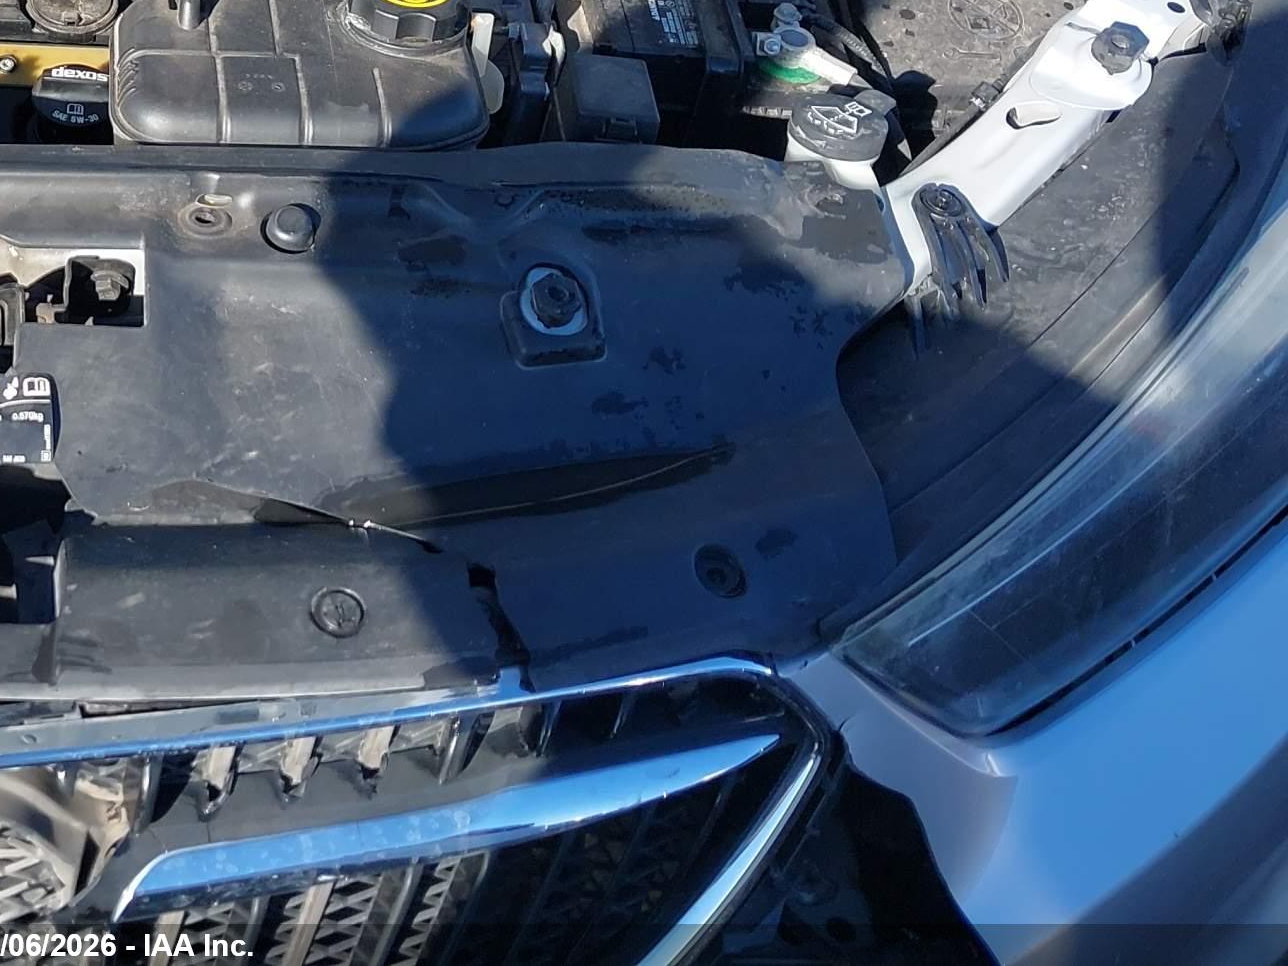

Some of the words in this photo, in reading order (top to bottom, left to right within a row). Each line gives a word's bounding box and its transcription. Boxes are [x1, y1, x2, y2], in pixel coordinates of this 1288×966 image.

[52, 66, 109, 82] dexos
[52, 109, 68, 121] SAE
[70, 114, 99, 124] 5W-30
